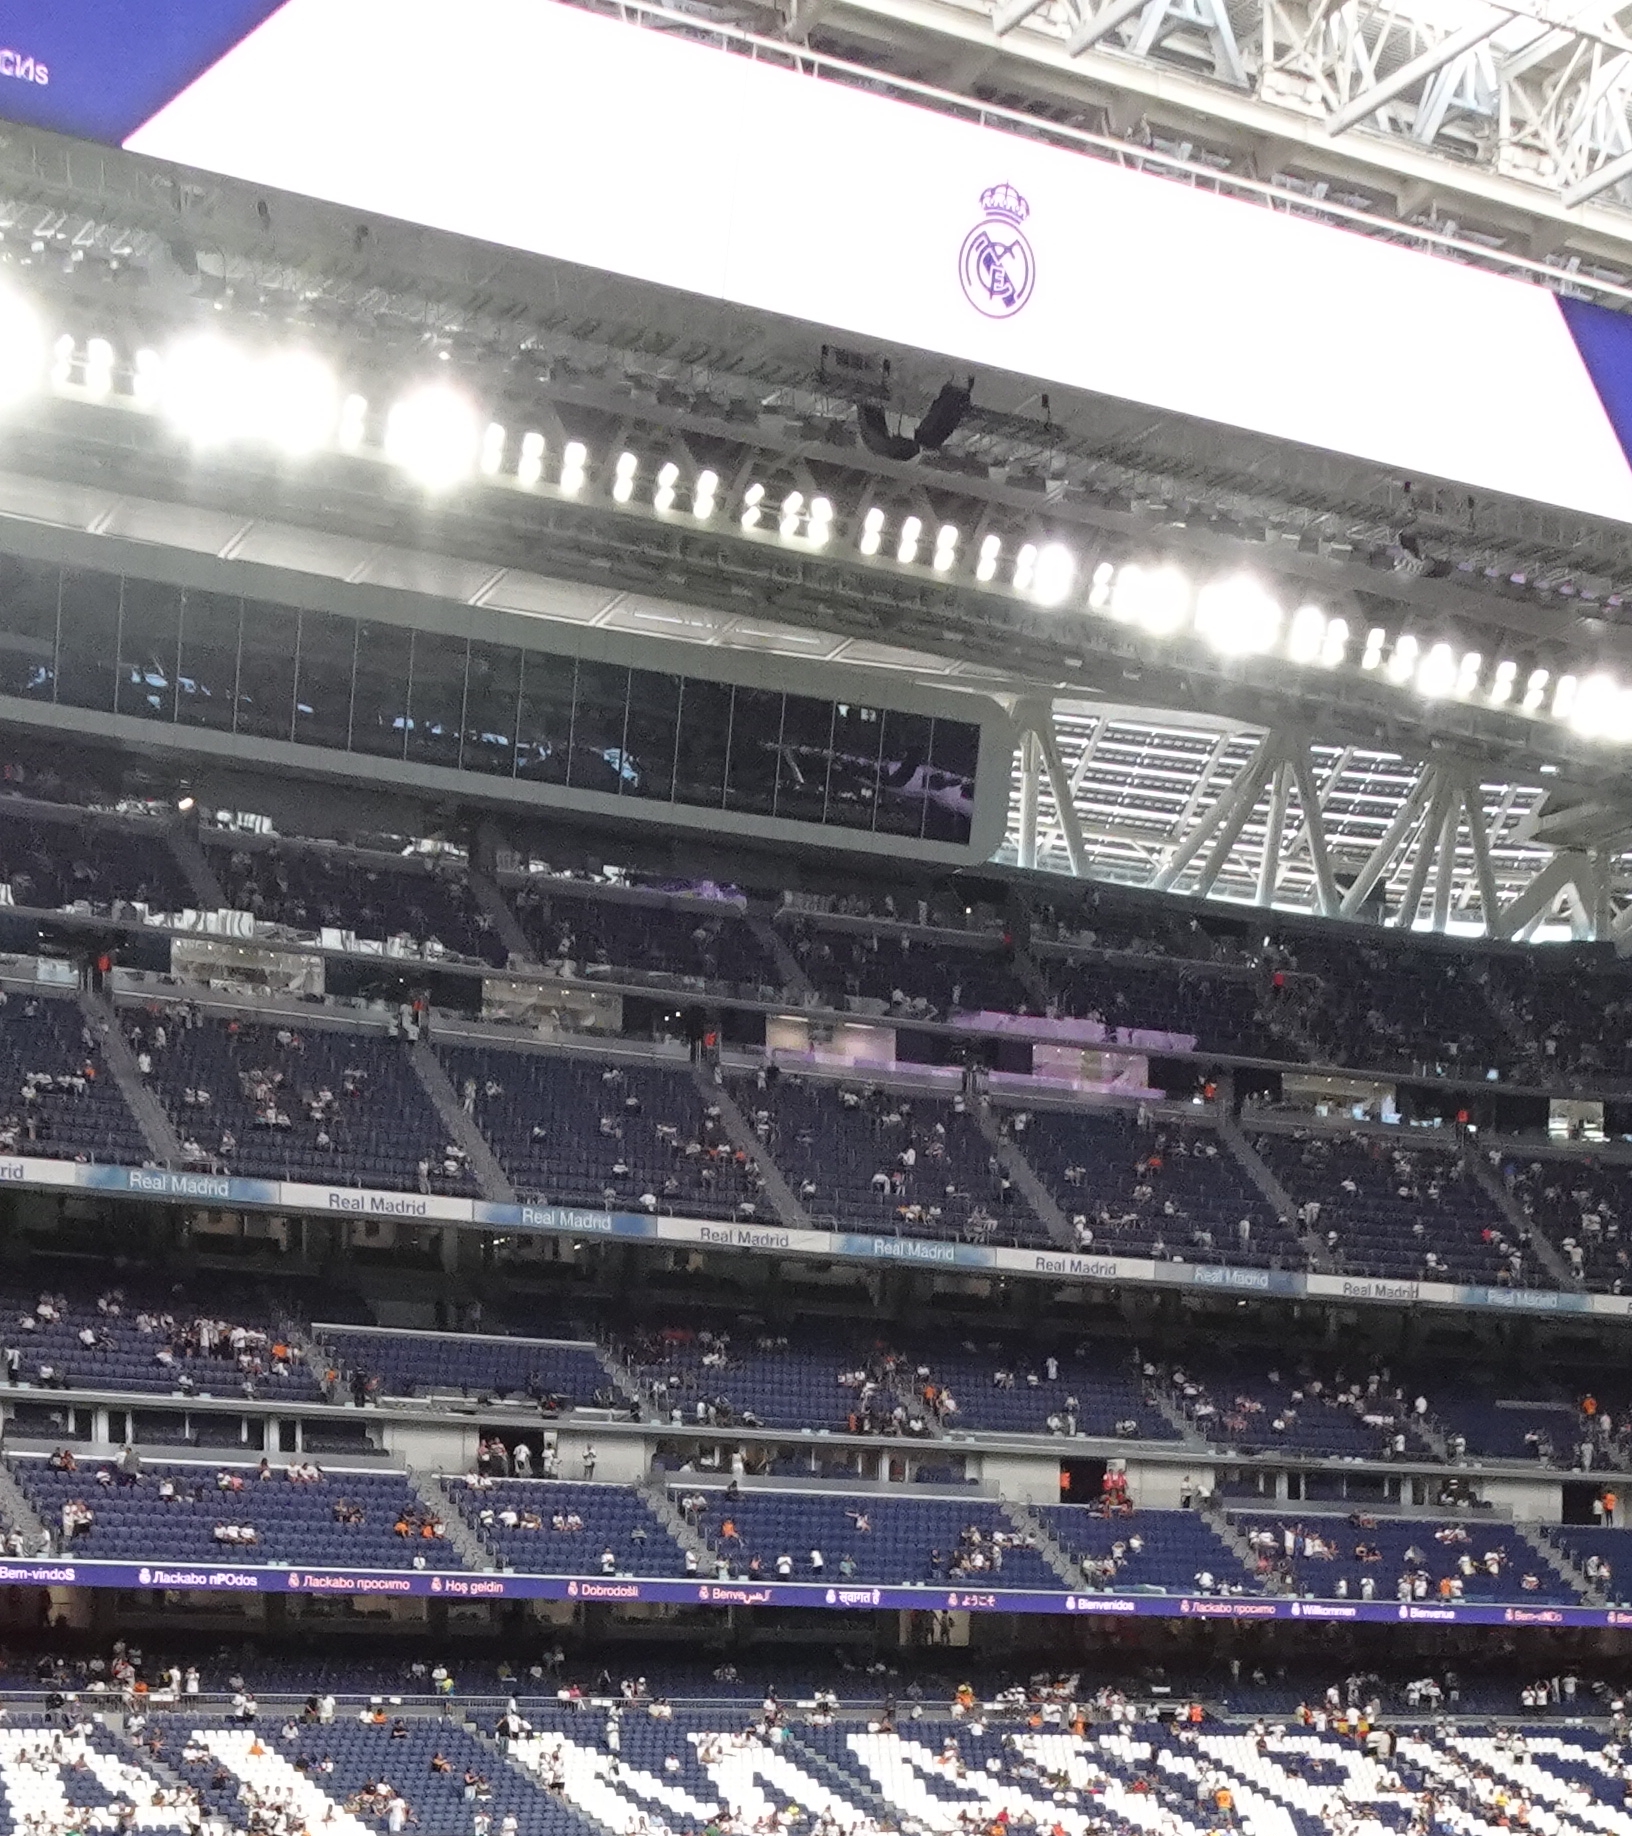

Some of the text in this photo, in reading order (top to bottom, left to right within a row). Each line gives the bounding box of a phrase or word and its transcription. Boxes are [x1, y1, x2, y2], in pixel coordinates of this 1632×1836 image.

[129, 1172, 229, 1197] Real Madrid
[329, 1192, 427, 1216] Real Madrid
[522, 1208, 612, 1231] Real Madrid
[699, 1227, 789, 1248] Real Madrid
[874, 1240, 954, 1261] Real Madrid
[1035, 1256, 1117, 1276] Real Madrid
[1343, 1283, 1419, 1300] Real Madrid
[470, 1581, 503, 1596] geldin
[1078, 1598, 1135, 1611] Bienvenidos
